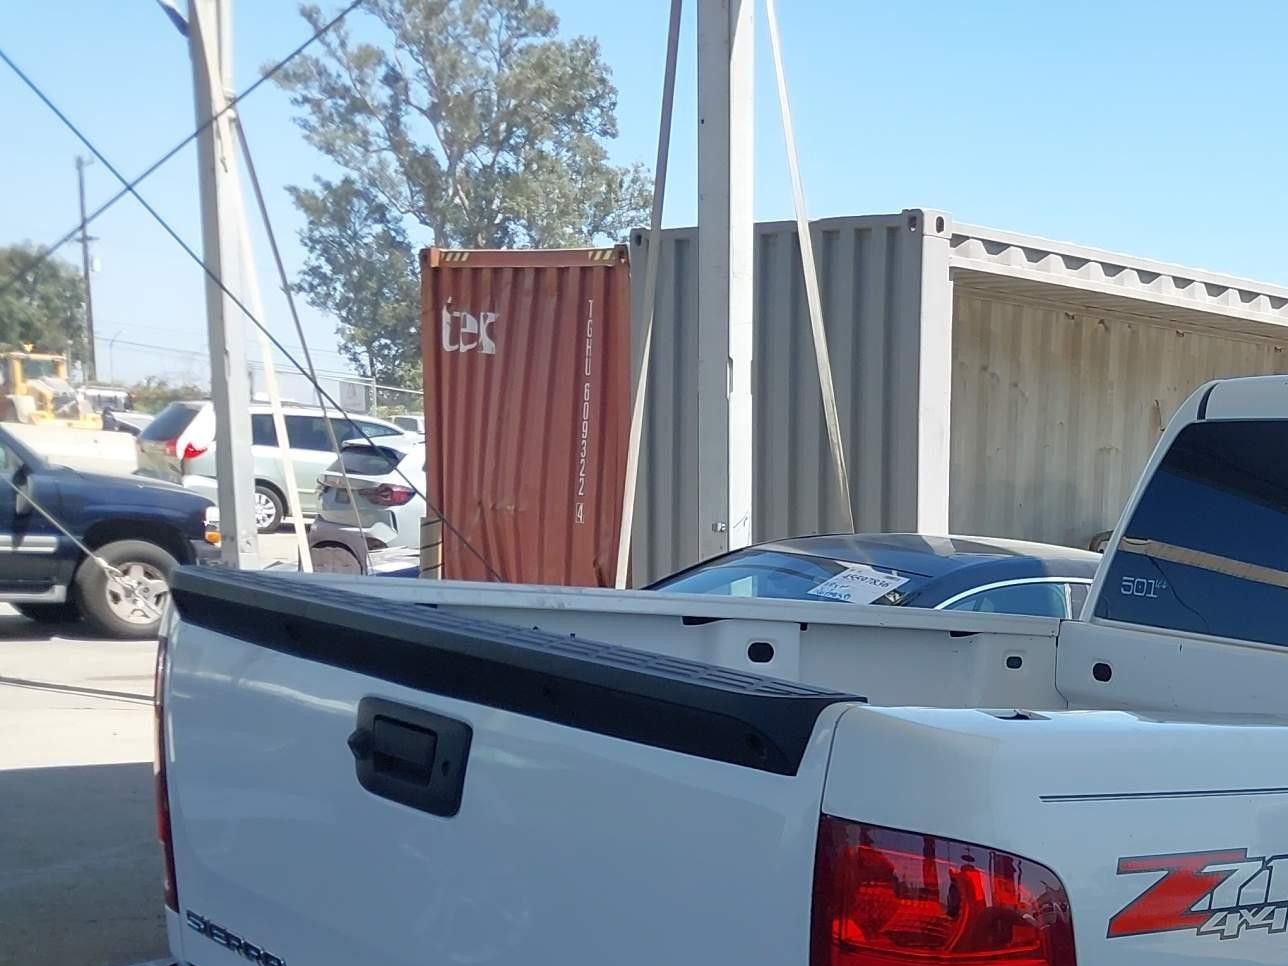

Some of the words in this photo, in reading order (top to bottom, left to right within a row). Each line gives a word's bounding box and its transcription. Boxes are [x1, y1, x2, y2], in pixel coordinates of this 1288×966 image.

[441, 296, 497, 354] tex
[585, 299, 593, 375] TGHU
[578, 382, 591, 496] 609322
[575, 502, 585, 523] 4
[1120, 576, 1158, 599] 501
